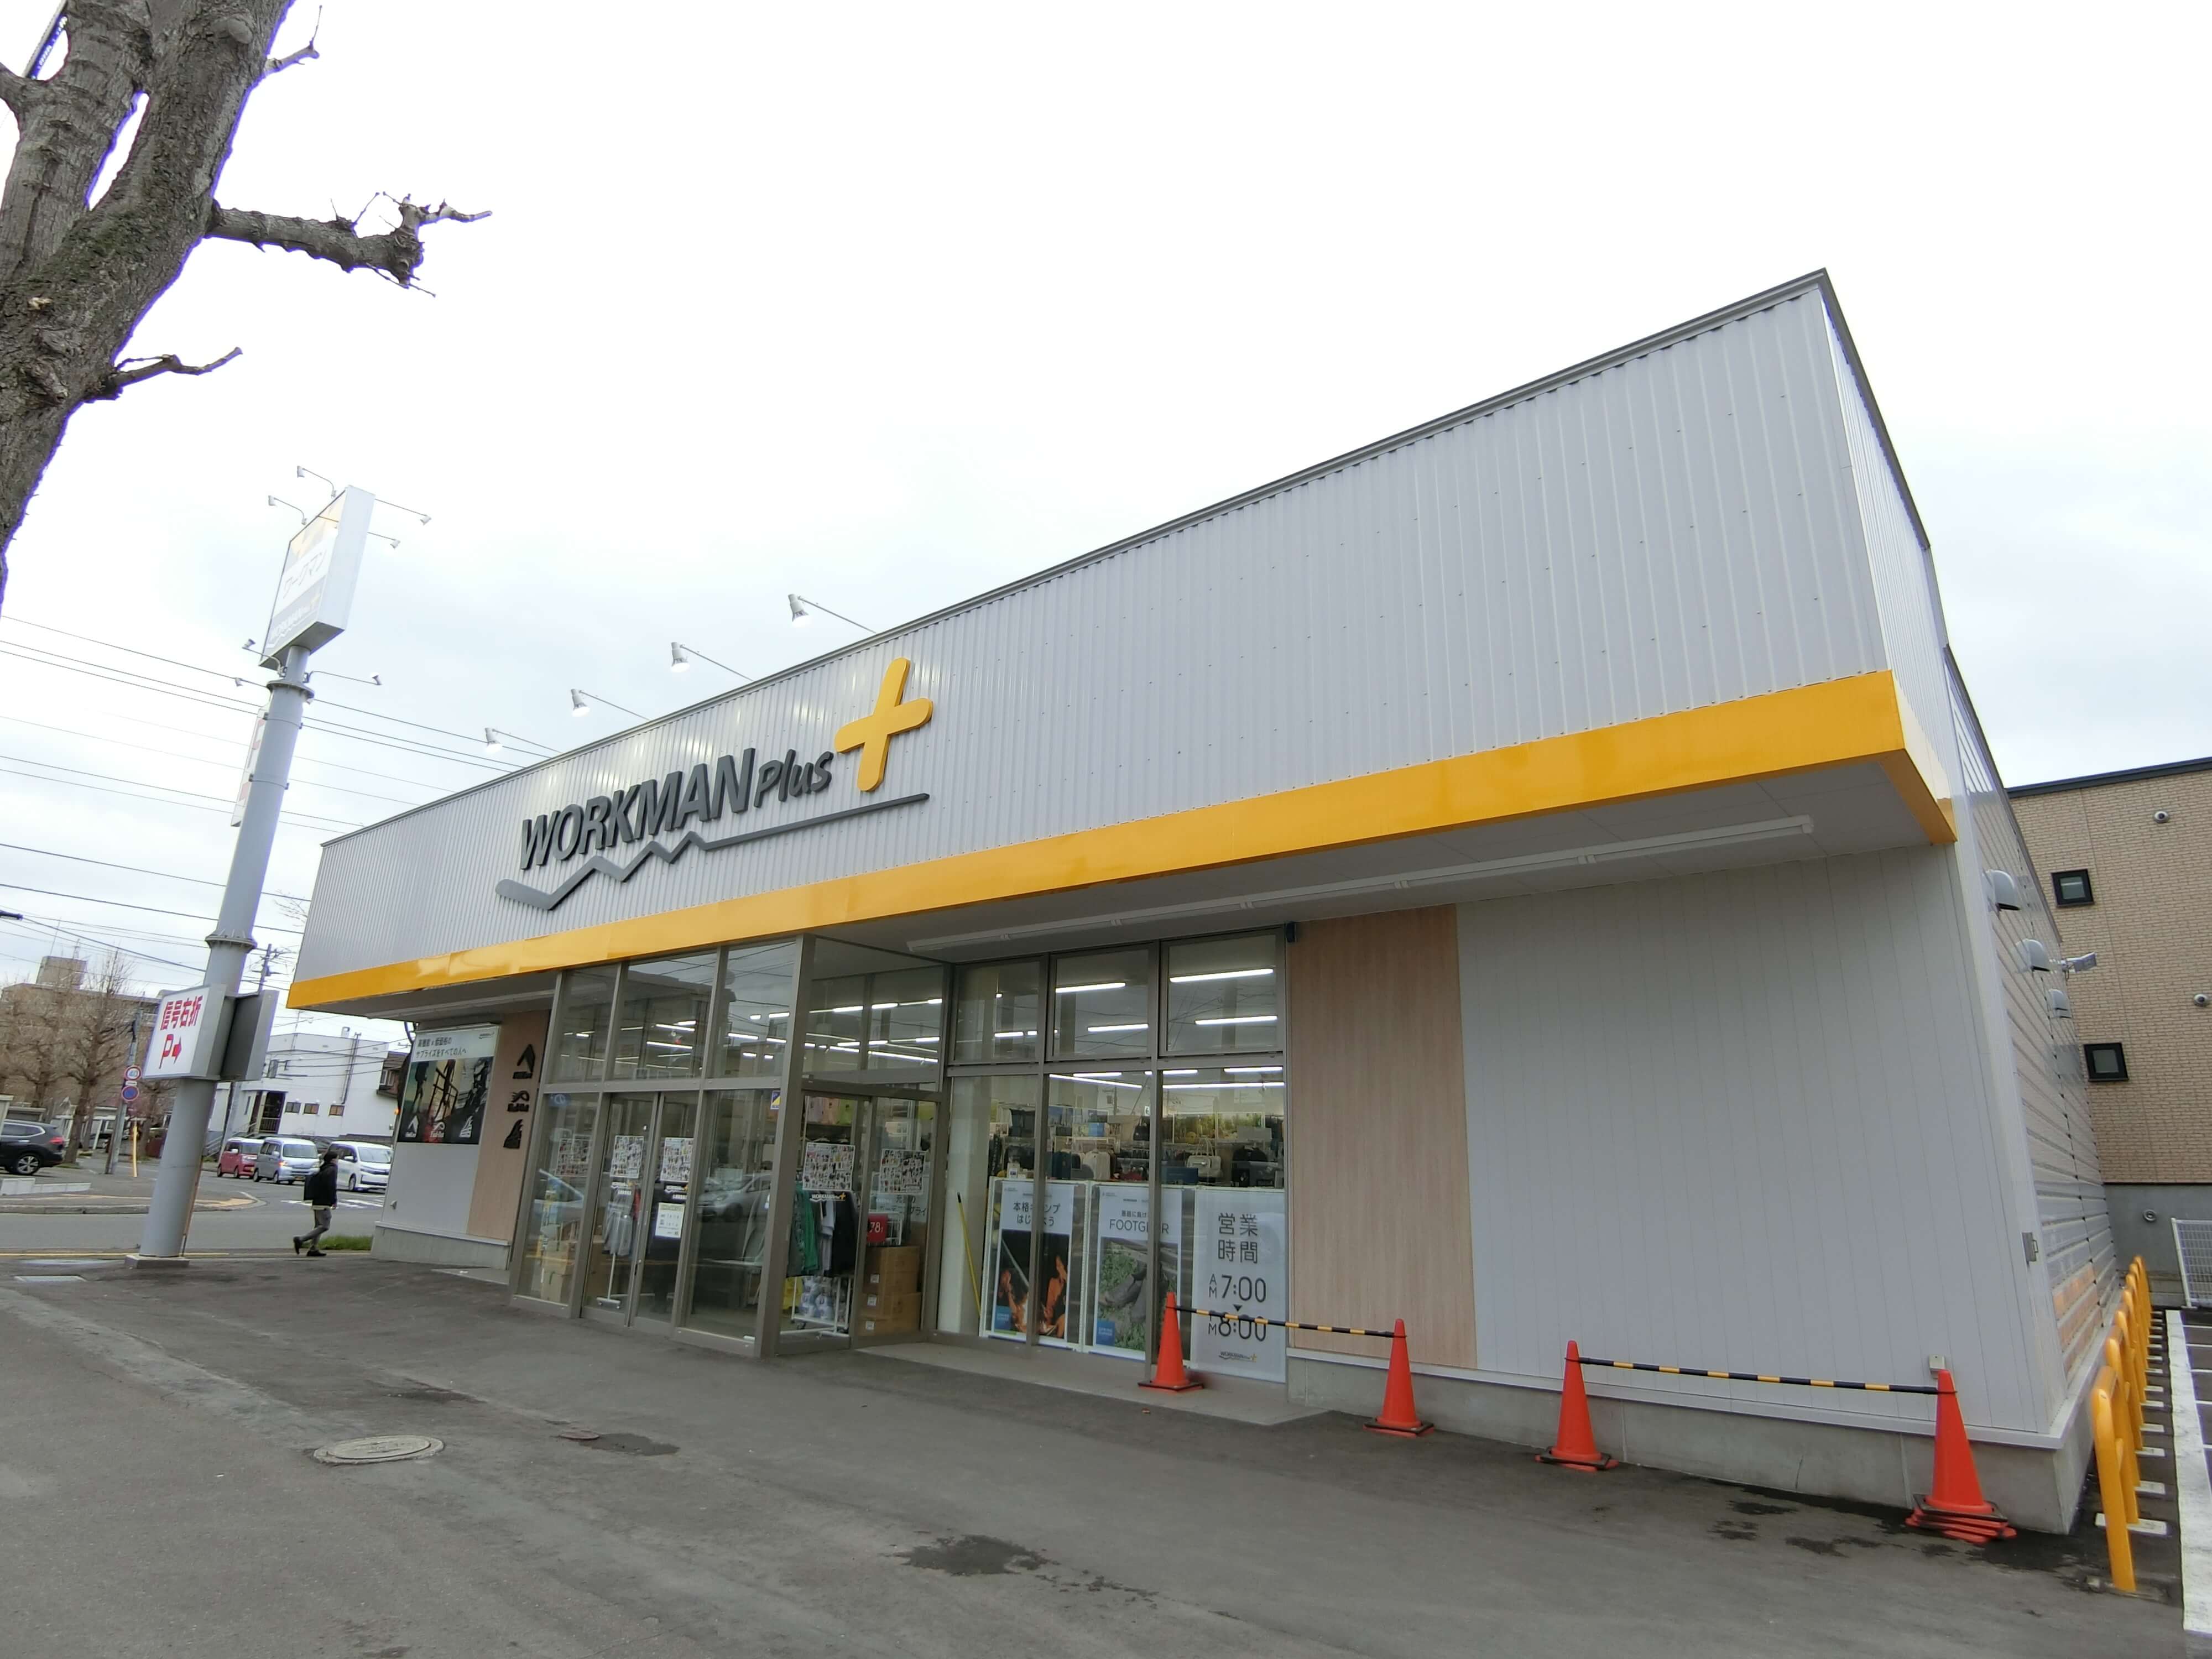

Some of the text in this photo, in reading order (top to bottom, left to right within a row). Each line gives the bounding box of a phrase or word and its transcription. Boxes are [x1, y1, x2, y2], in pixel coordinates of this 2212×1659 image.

[520, 747, 834, 870] WORKMAN Plus
[160, 995, 204, 1030] 信号右折
[159, 1034, 174, 1069] P
[1013, 1201, 1061, 1214] 本格ンプ
[1016, 1214, 1055, 1227] はじう
[1109, 1218, 1169, 1235] FOOTGR
[1218, 1212, 1258, 1237] 営業
[1218, 1239, 1258, 1264] 時間
[1221, 1274, 1266, 1303] 7:00
